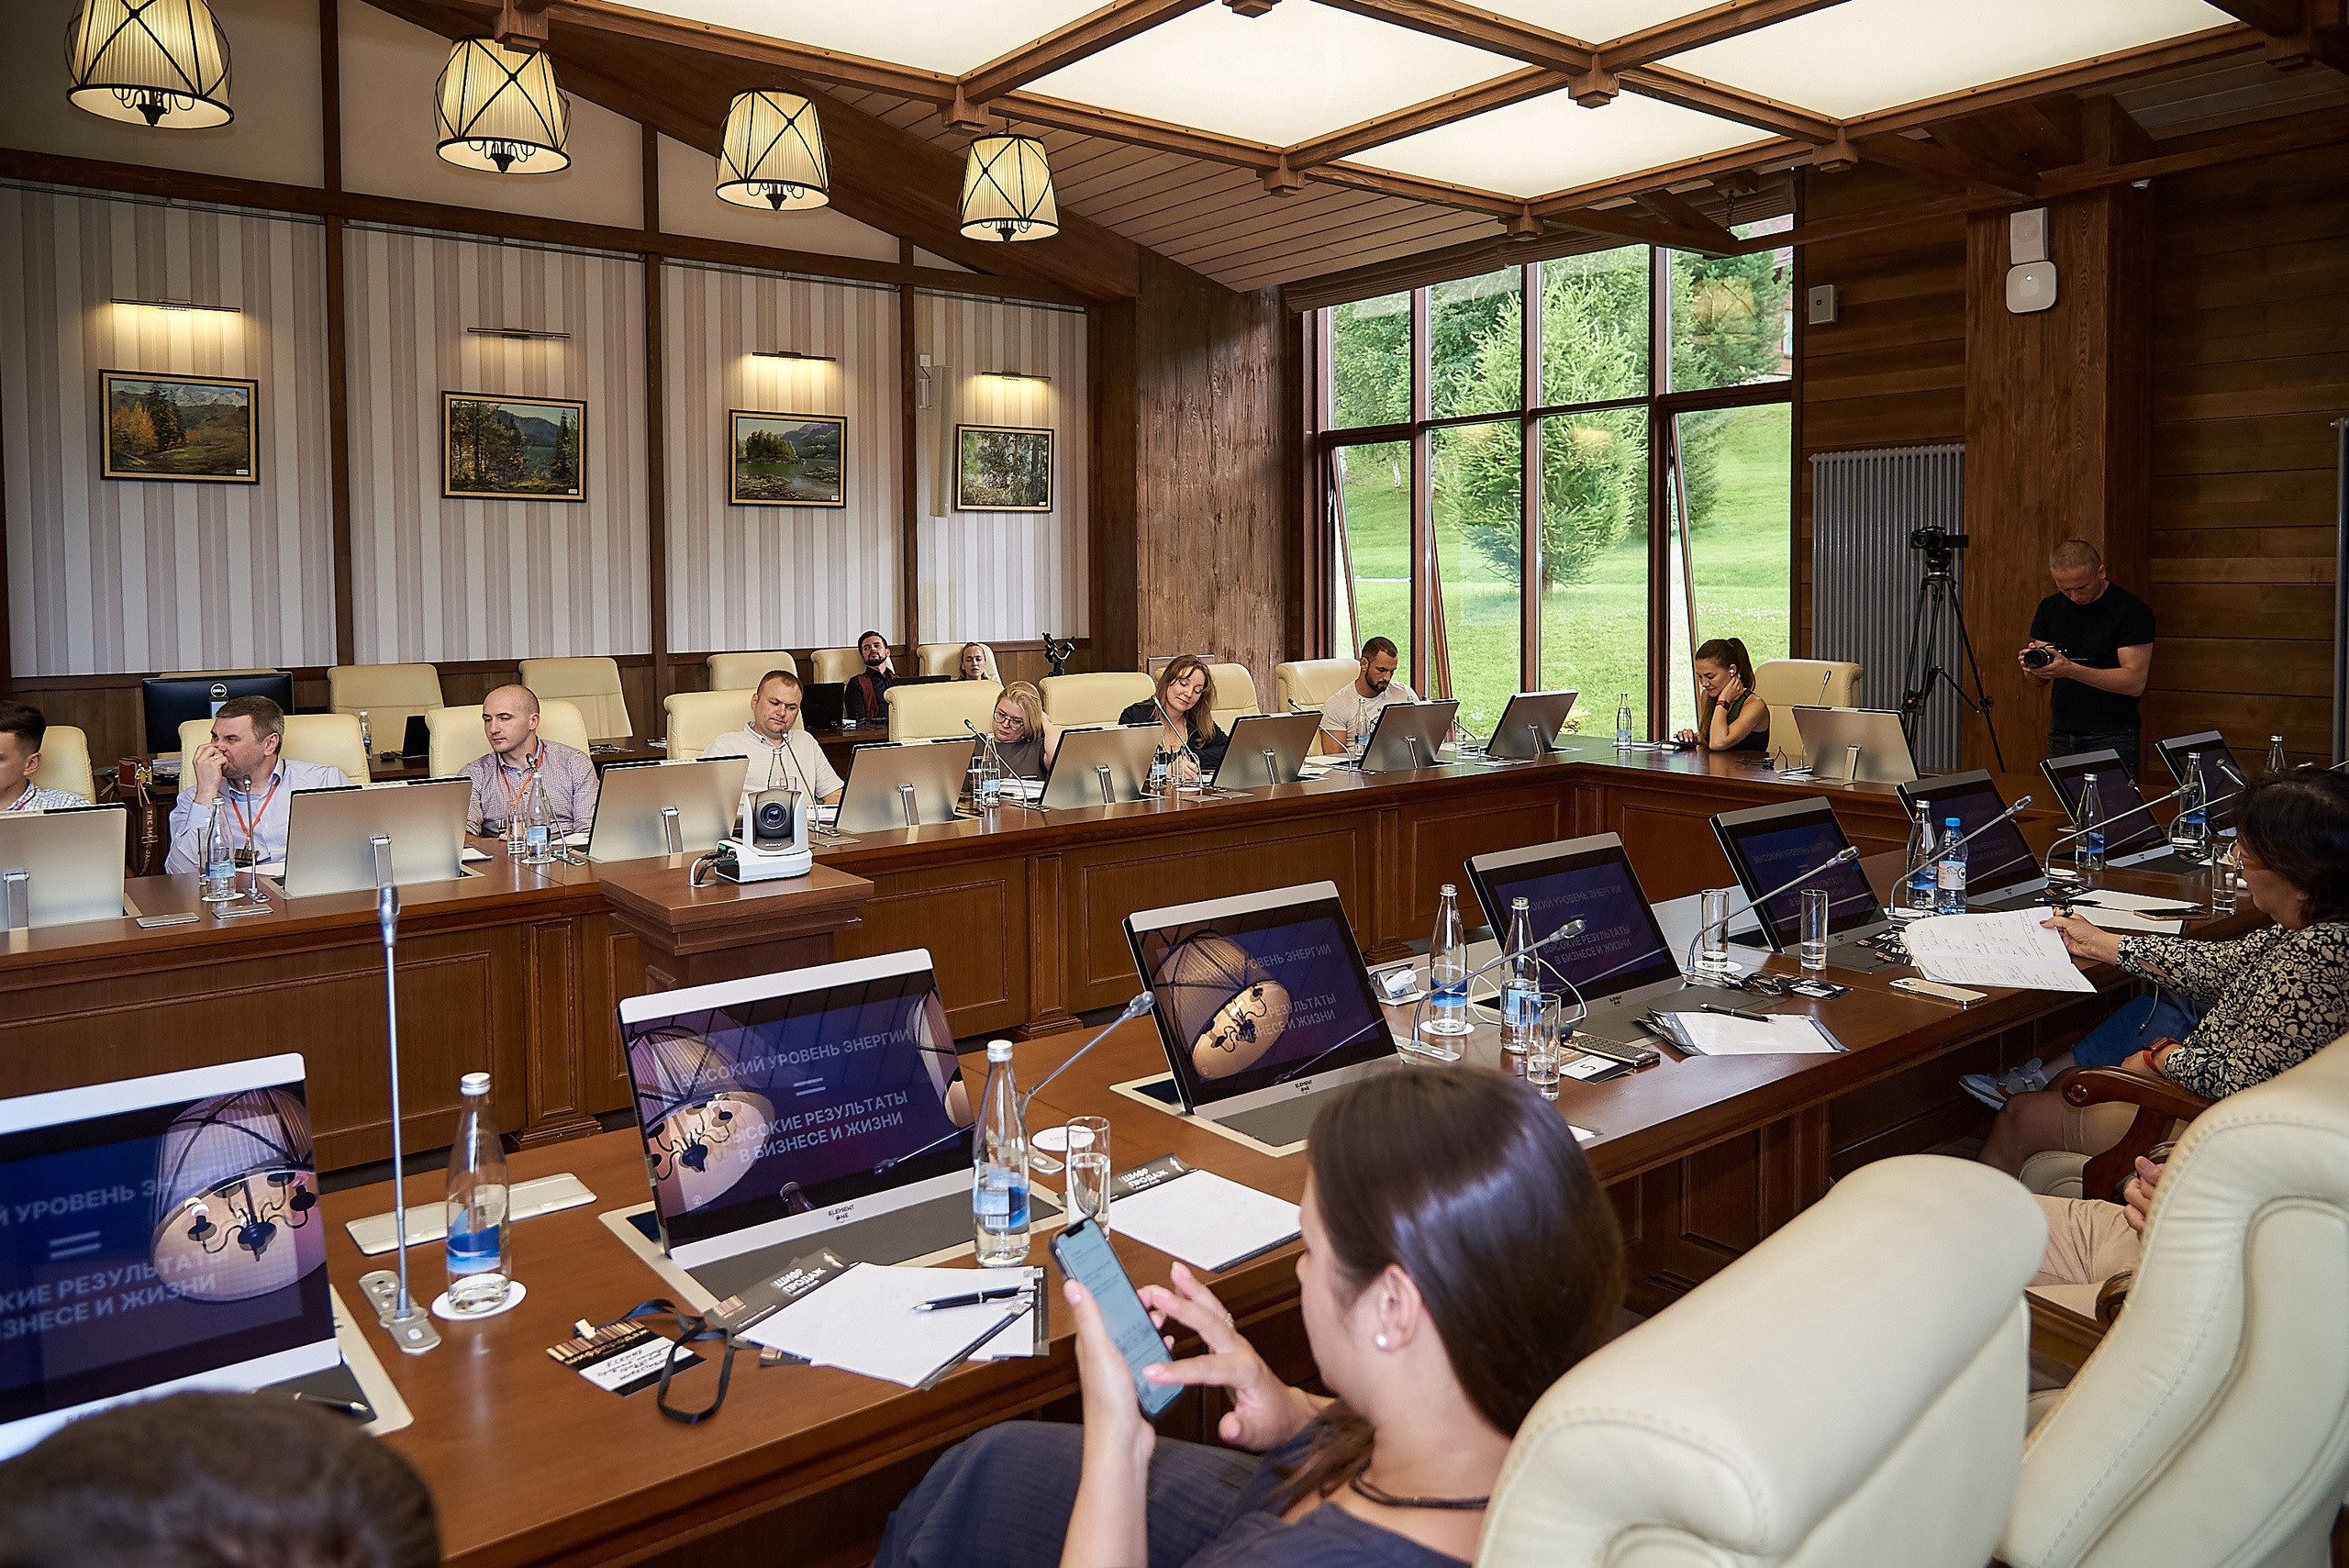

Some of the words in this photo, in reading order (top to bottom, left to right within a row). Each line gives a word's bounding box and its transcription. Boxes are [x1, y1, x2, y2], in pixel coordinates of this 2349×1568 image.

[1553, 892, 1587, 907] УРОВЕНЬ
[1588, 884, 1622, 899] ЭНЕРГИИ
[1542, 938, 1582, 954] ВЫСОКИЕ
[1582, 925, 1631, 943] РЕЗУЛЬТАТЫ
[1554, 955, 1561, 964] В
[1561, 949, 1597, 963] БИЗНЕСЕ
[1604, 938, 1632, 952] ЖИЗНИ
[1286, 943, 1330, 963] ЭНЕРГИИ
[1267, 993, 1337, 1017] РЕЗУЛЬТАТЫ
[1288, 1018, 1297, 1029] И
[1297, 1009, 1337, 1028] ЖИЗНИ
[768, 1044, 840, 1069] УРОВЕНЬ
[843, 1028, 909, 1053] ЭНЕРГИИ
[805, 1090, 908, 1127] РЕЗУЛЬТАТЫ
[740, 1148, 751, 1163] В
[756, 1130, 829, 1159] БИЗНЕСЕ
[830, 1124, 842, 1140] И
[845, 1111, 905, 1138] ЖИЗНИ
[1120, 1167, 1149, 1183] ШИФР
[1128, 1169, 1169, 1187] ПРОДАЖ
[16, 1184, 137, 1224] УРОВЕНЬ
[828, 1204, 854, 1217] ELEMENT
[55, 1251, 228, 1300] РЕЗУЛЬТАТЫ
[773, 1268, 804, 1286] ШИФР
[782, 1267, 827, 1293] ПРОДАЖ
[95, 1297, 115, 1318] И
[119, 1273, 216, 1312] ЖИЗНИ
